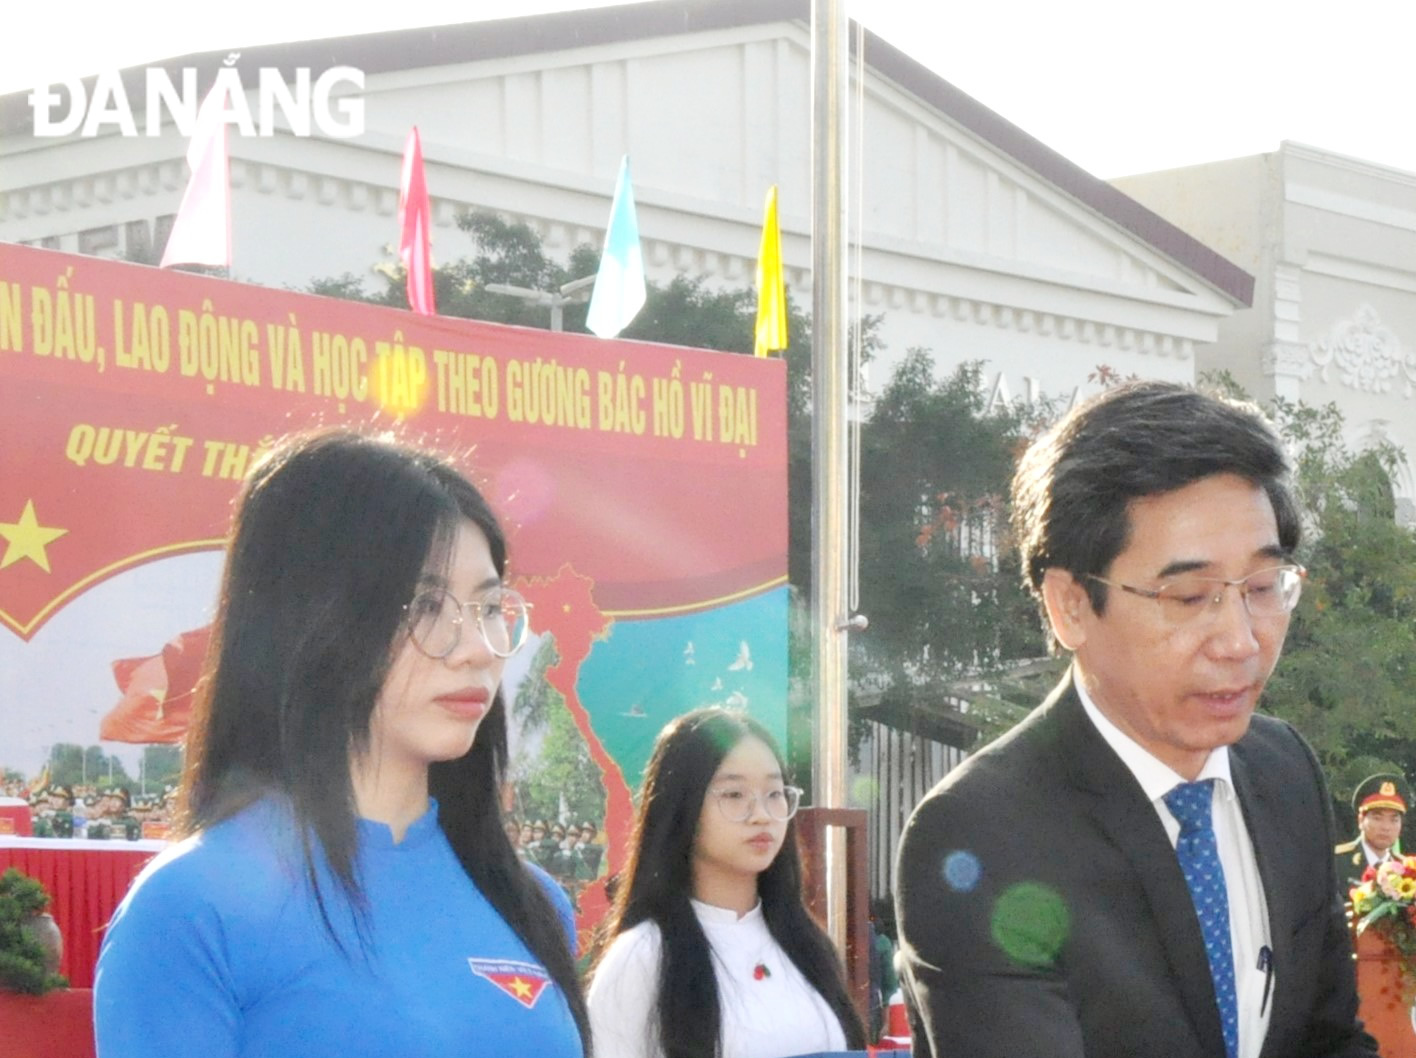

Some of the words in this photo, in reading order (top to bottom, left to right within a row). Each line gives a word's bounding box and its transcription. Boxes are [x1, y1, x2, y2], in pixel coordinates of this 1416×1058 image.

[32, 266, 105, 373] ĐẤU,
[114, 298, 170, 374] LAO
[178, 298, 260, 395] ĐỘNG
[267, 312, 306, 393] VÀ
[311, 331, 368, 414] HỌC
[375, 330, 427, 420] TẬP
[433, 350, 499, 419] THEO
[506, 357, 591, 429] GƯƠNG
[598, 360, 645, 436] BÁC
[653, 359, 684, 440] HỒ
[690, 371, 713, 442] VĨ
[718, 384, 758, 459] ĐẠI
[66, 423, 194, 474] QUYẾT
